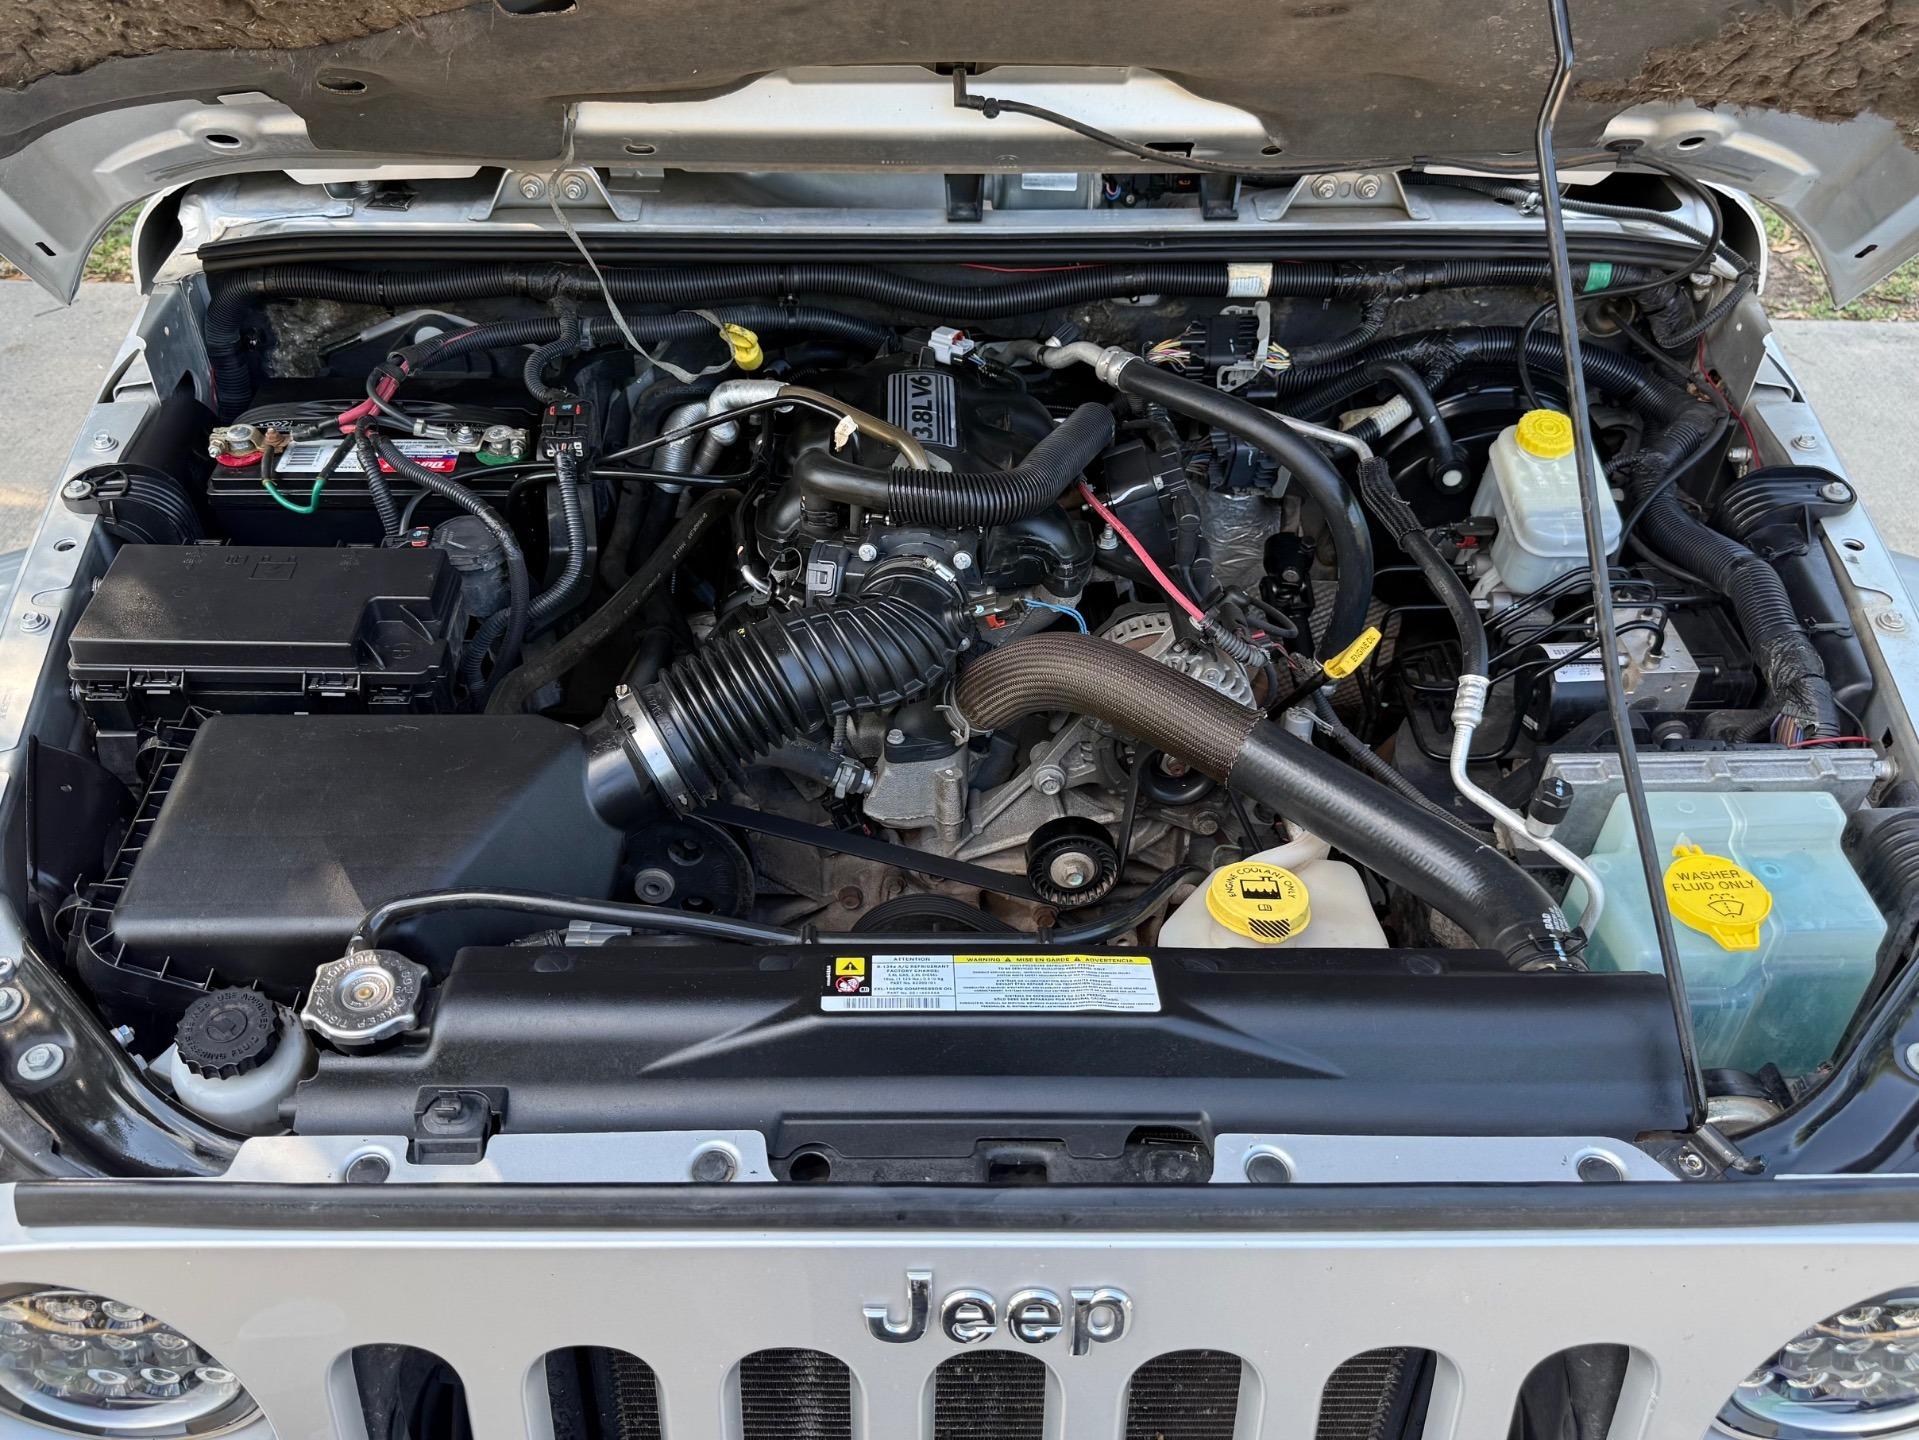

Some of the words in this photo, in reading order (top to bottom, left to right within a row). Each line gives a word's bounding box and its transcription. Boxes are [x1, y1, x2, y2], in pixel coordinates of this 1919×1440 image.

[910, 375, 933, 398] V6
[911, 400, 933, 439] 3.8L
[1350, 641, 1370, 663] ENGINE
[1225, 873, 1238, 898] ENGINE
[1236, 867, 1284, 880] COOLANT
[1284, 880, 1296, 899] ONLY
[1672, 882, 1715, 892] FLUID
[1718, 879, 1755, 890] ONLY
[1676, 869, 1741, 881] WASHER
[217, 992, 238, 1002] USE
[316, 1008, 348, 1028] TIGHT
[357, 1006, 396, 1028] KEEP
[862, 1271, 1133, 1356] Jeep
